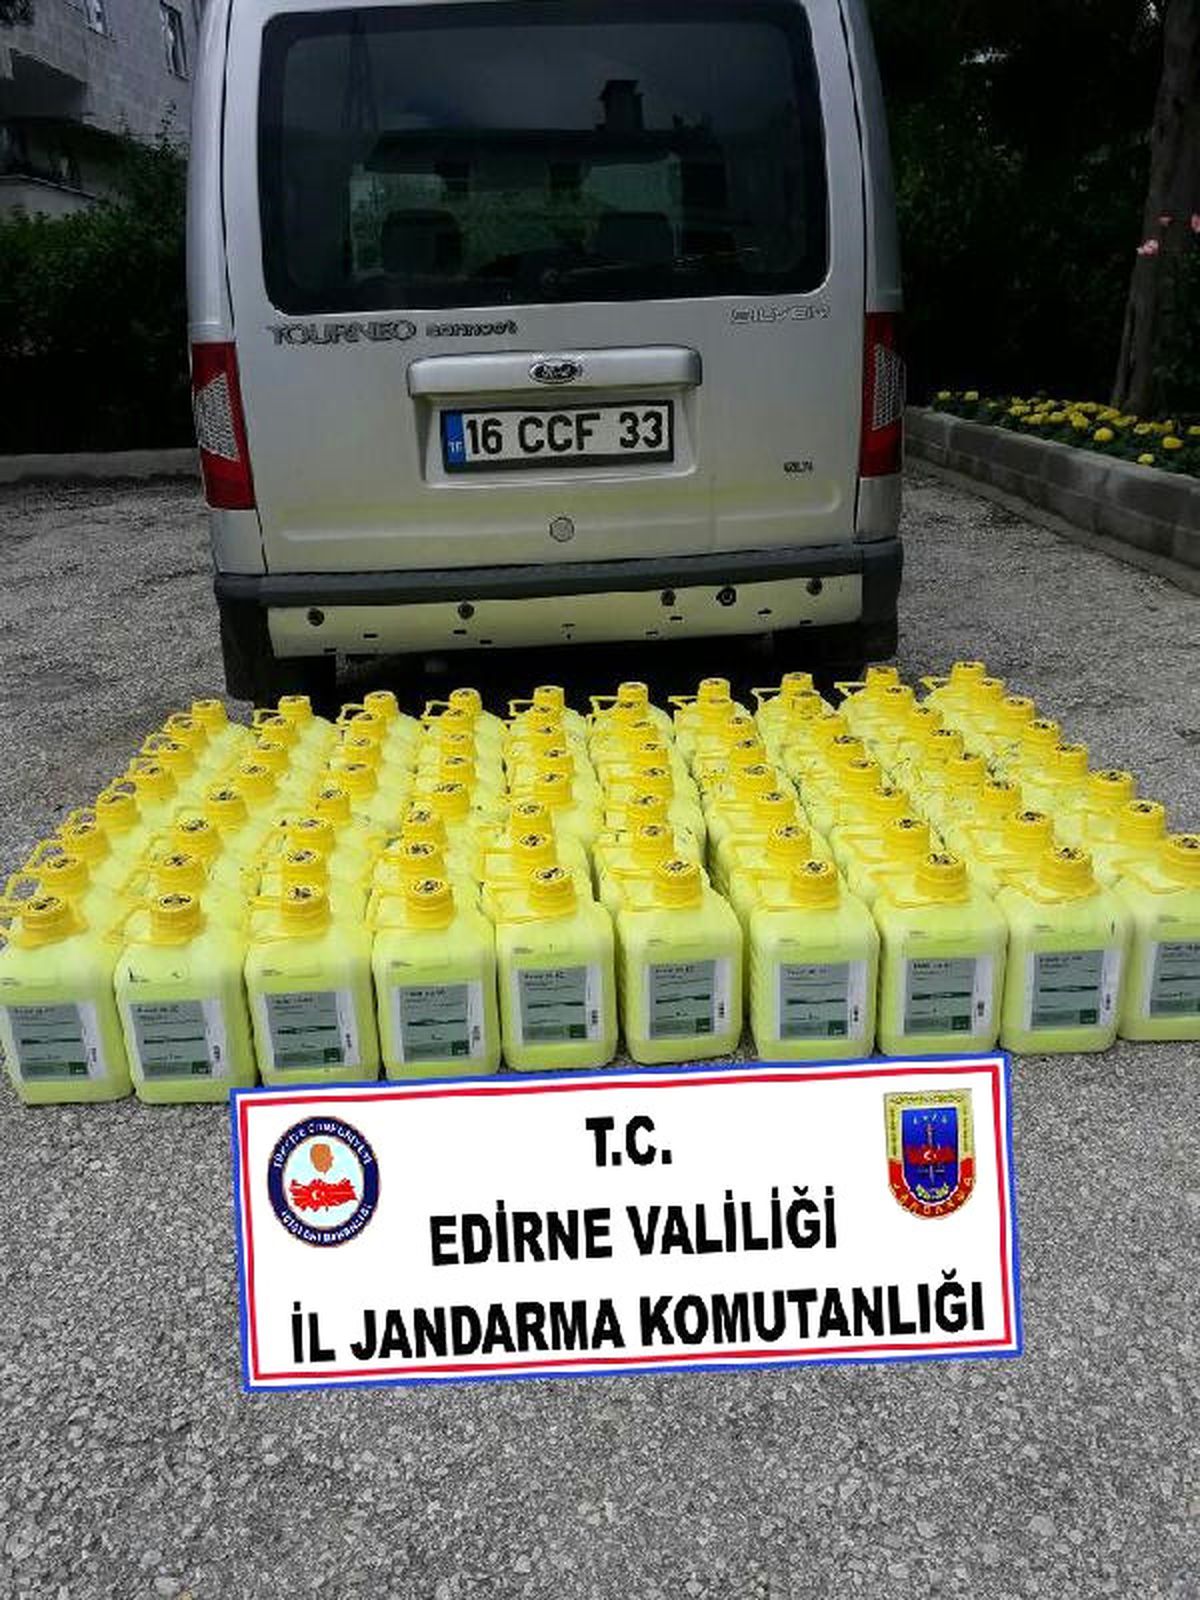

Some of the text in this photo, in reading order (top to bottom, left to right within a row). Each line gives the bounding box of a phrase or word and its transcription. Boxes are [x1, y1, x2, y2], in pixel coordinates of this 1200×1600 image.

[269, 320, 417, 345] TOURNEO
[466, 410, 663, 455] 16 CCF 33
